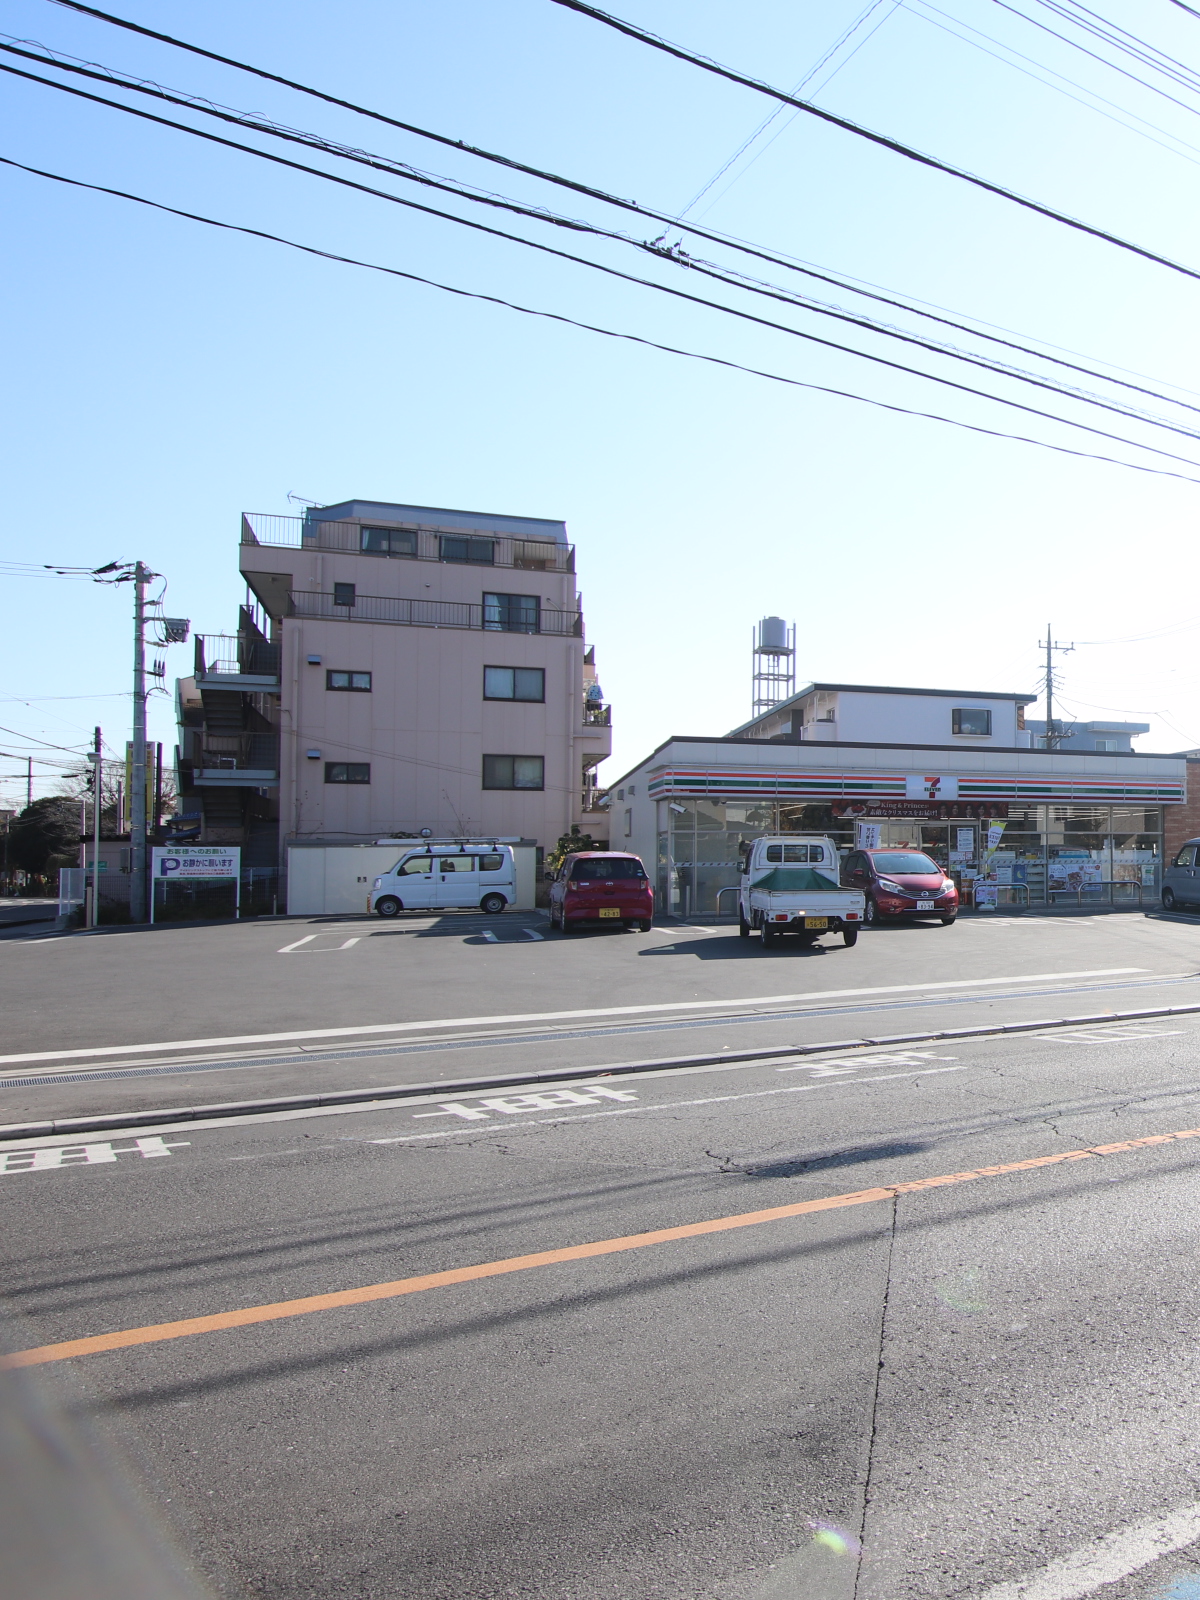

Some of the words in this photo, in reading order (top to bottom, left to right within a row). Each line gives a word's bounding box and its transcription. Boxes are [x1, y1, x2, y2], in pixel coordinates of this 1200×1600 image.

[924, 776, 941, 799] 7
[161, 858, 180, 876] P
[182, 859, 234, 868] お静かに願います
